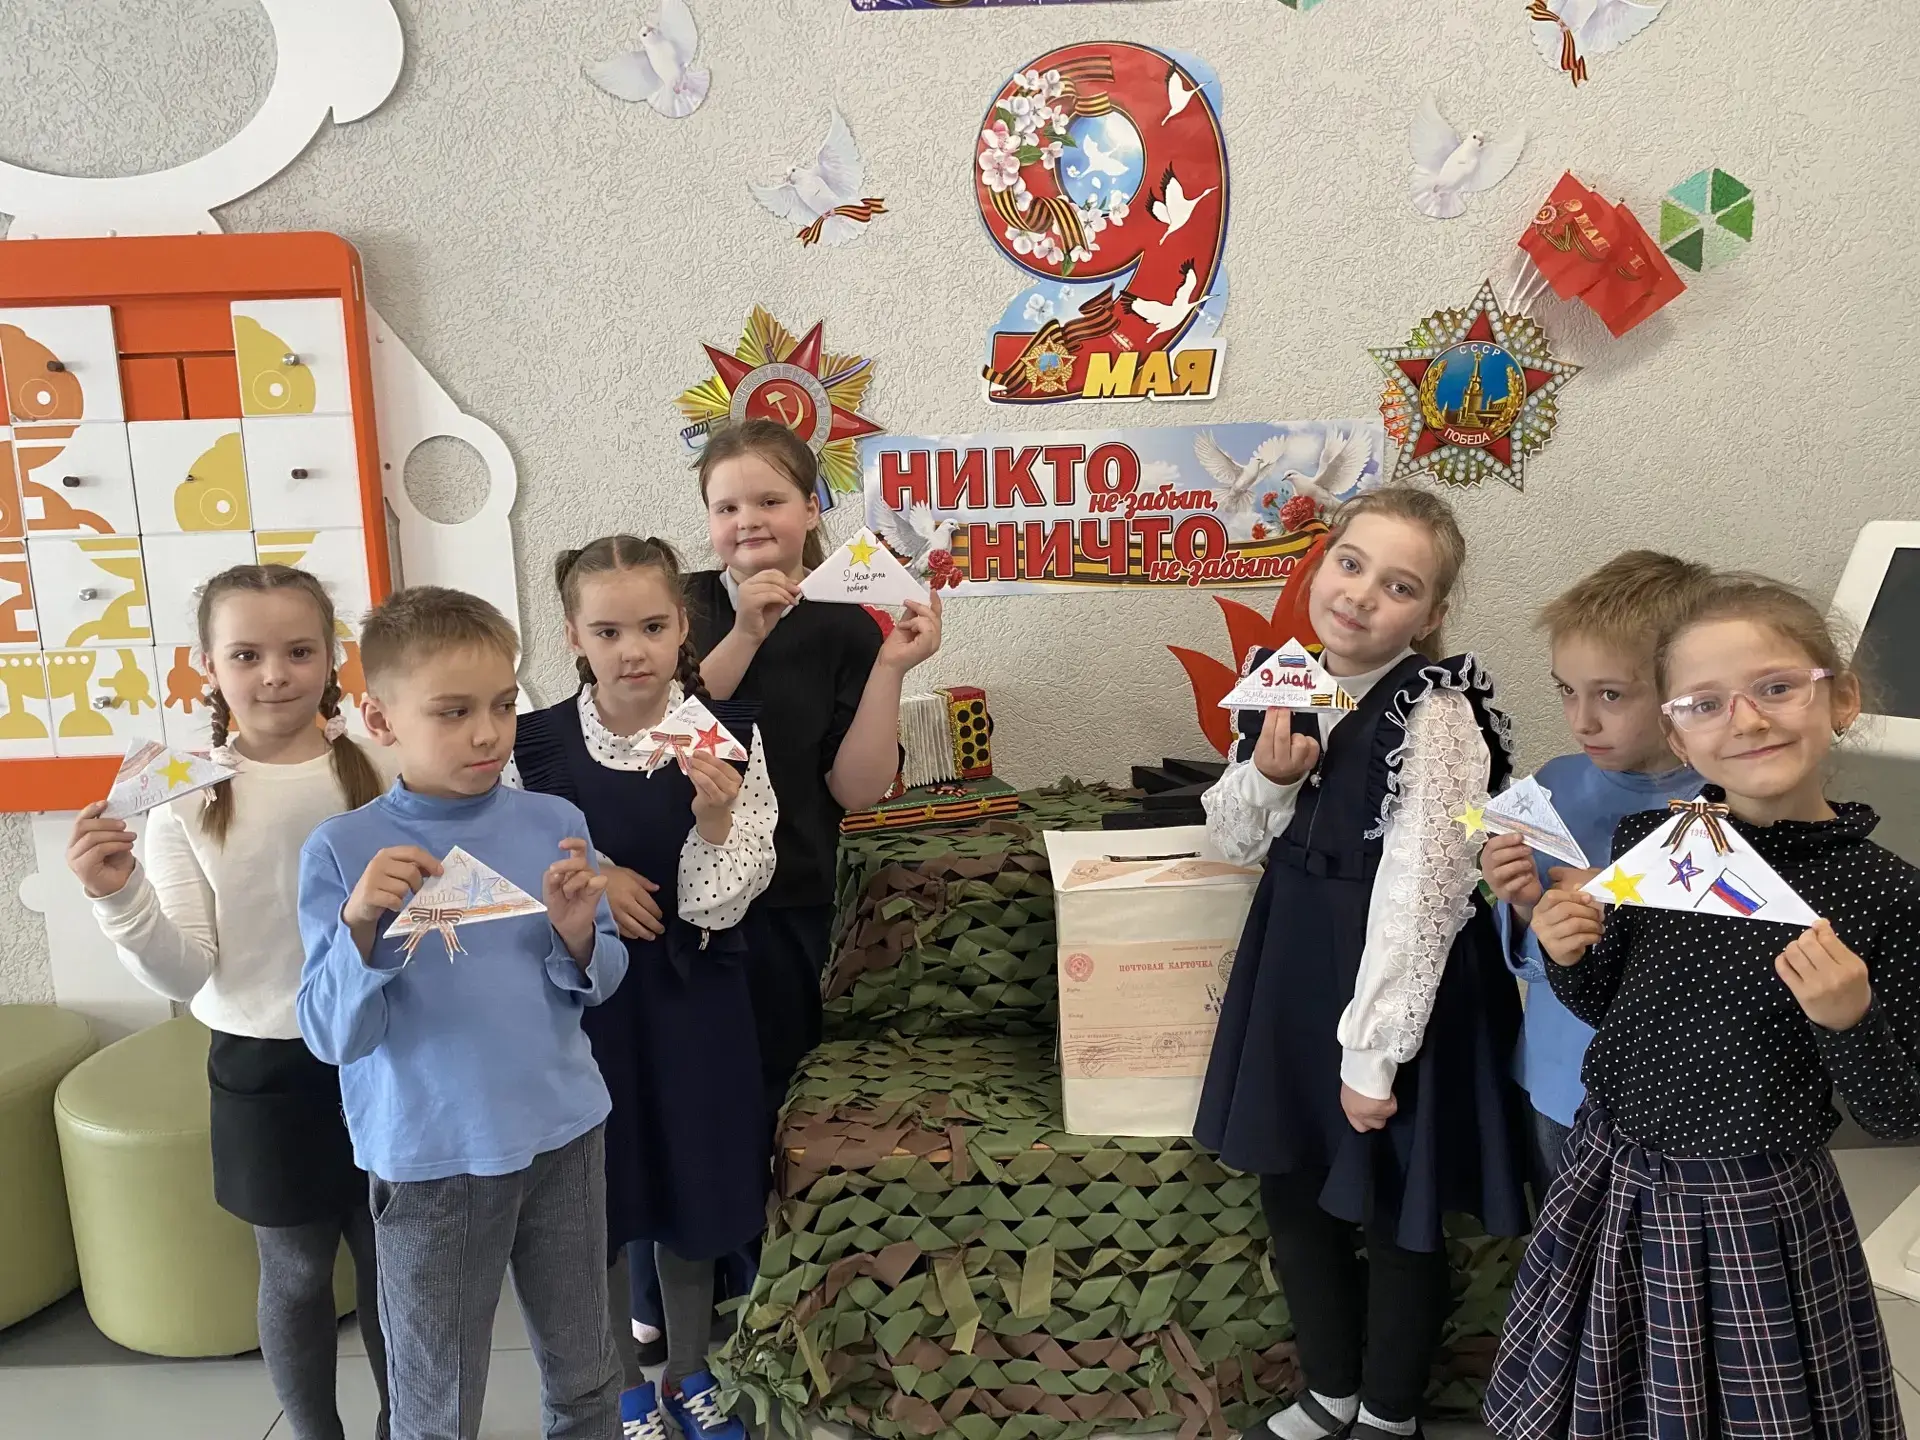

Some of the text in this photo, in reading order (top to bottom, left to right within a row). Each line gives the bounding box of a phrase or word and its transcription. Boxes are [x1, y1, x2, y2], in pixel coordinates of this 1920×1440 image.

[1458, 343, 1501, 357] СССР
[1082, 349, 1217, 399] МАЯ
[1443, 427, 1491, 445] ПОБЕДА
[879, 441, 1141, 511] НИКТО
[1088, 482, 1219, 520] не забыт,
[967, 513, 1229, 582] НИЧТО
[1149, 550, 1297, 588] не забыто
[1260, 668, 1274, 687] 9
[1118, 959, 1214, 973] ПОЧТОВАЯ КАРТОЧКА
